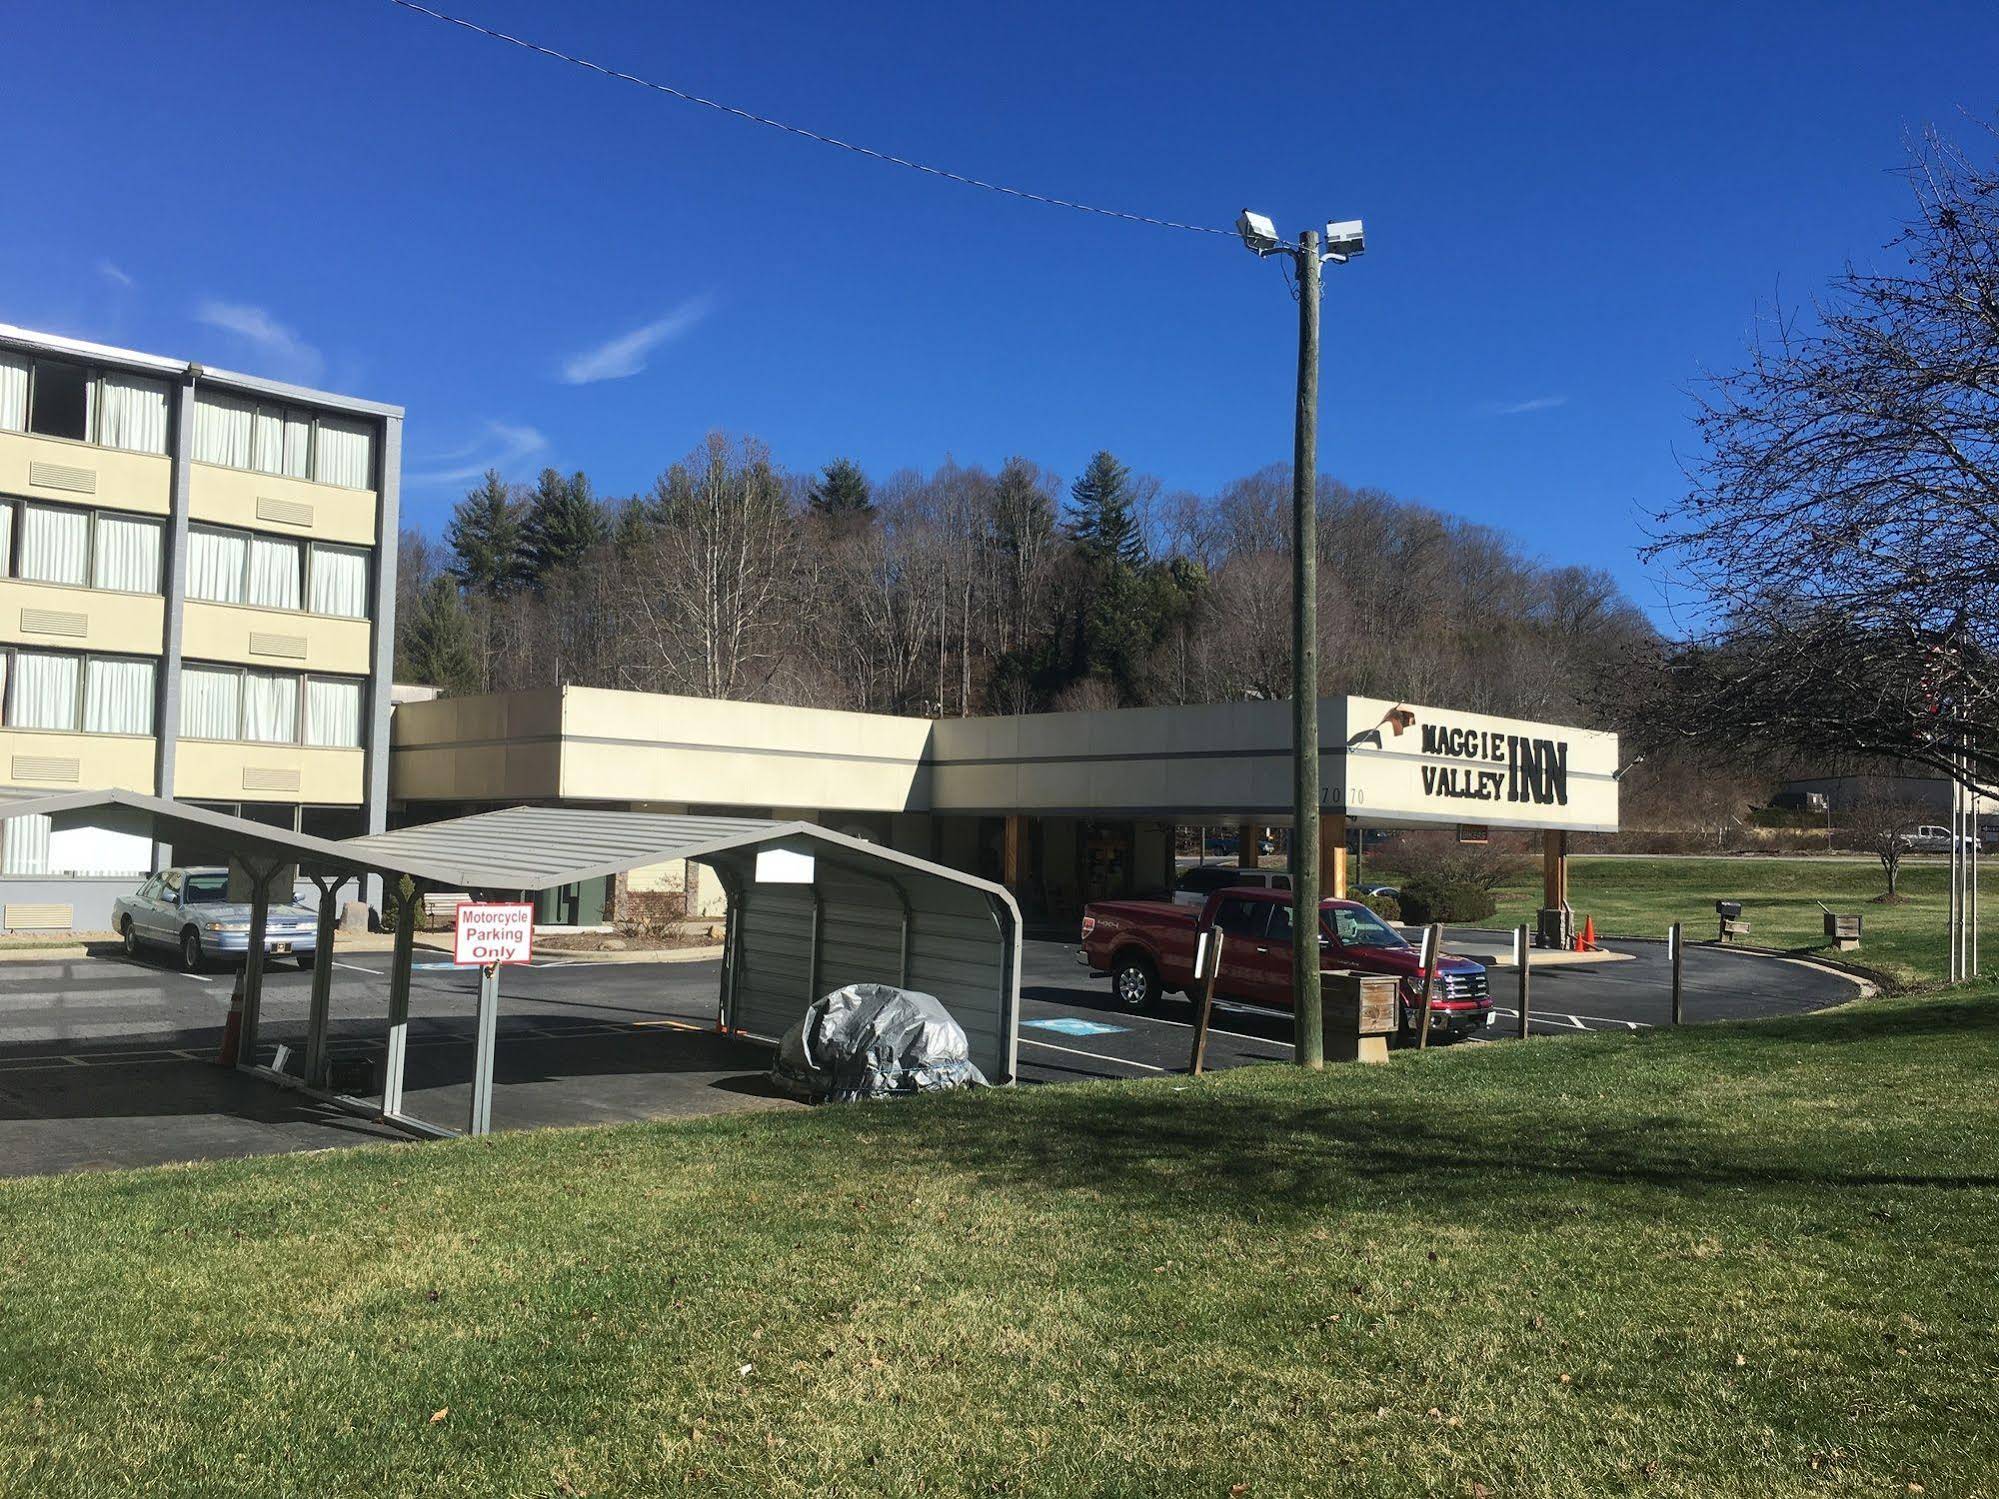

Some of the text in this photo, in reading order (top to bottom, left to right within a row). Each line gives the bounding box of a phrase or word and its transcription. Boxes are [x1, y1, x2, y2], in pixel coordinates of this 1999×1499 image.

[1421, 724, 1505, 762] MAGGIE
[1507, 735, 1568, 806] INN
[1421, 765, 1505, 801] VALLEY
[1322, 787, 1341, 803] 70
[1351, 788, 1364, 805] 70
[462, 910, 528, 926] Motorcycle
[466, 927, 523, 943] Parking
[472, 946, 516, 960] Only
